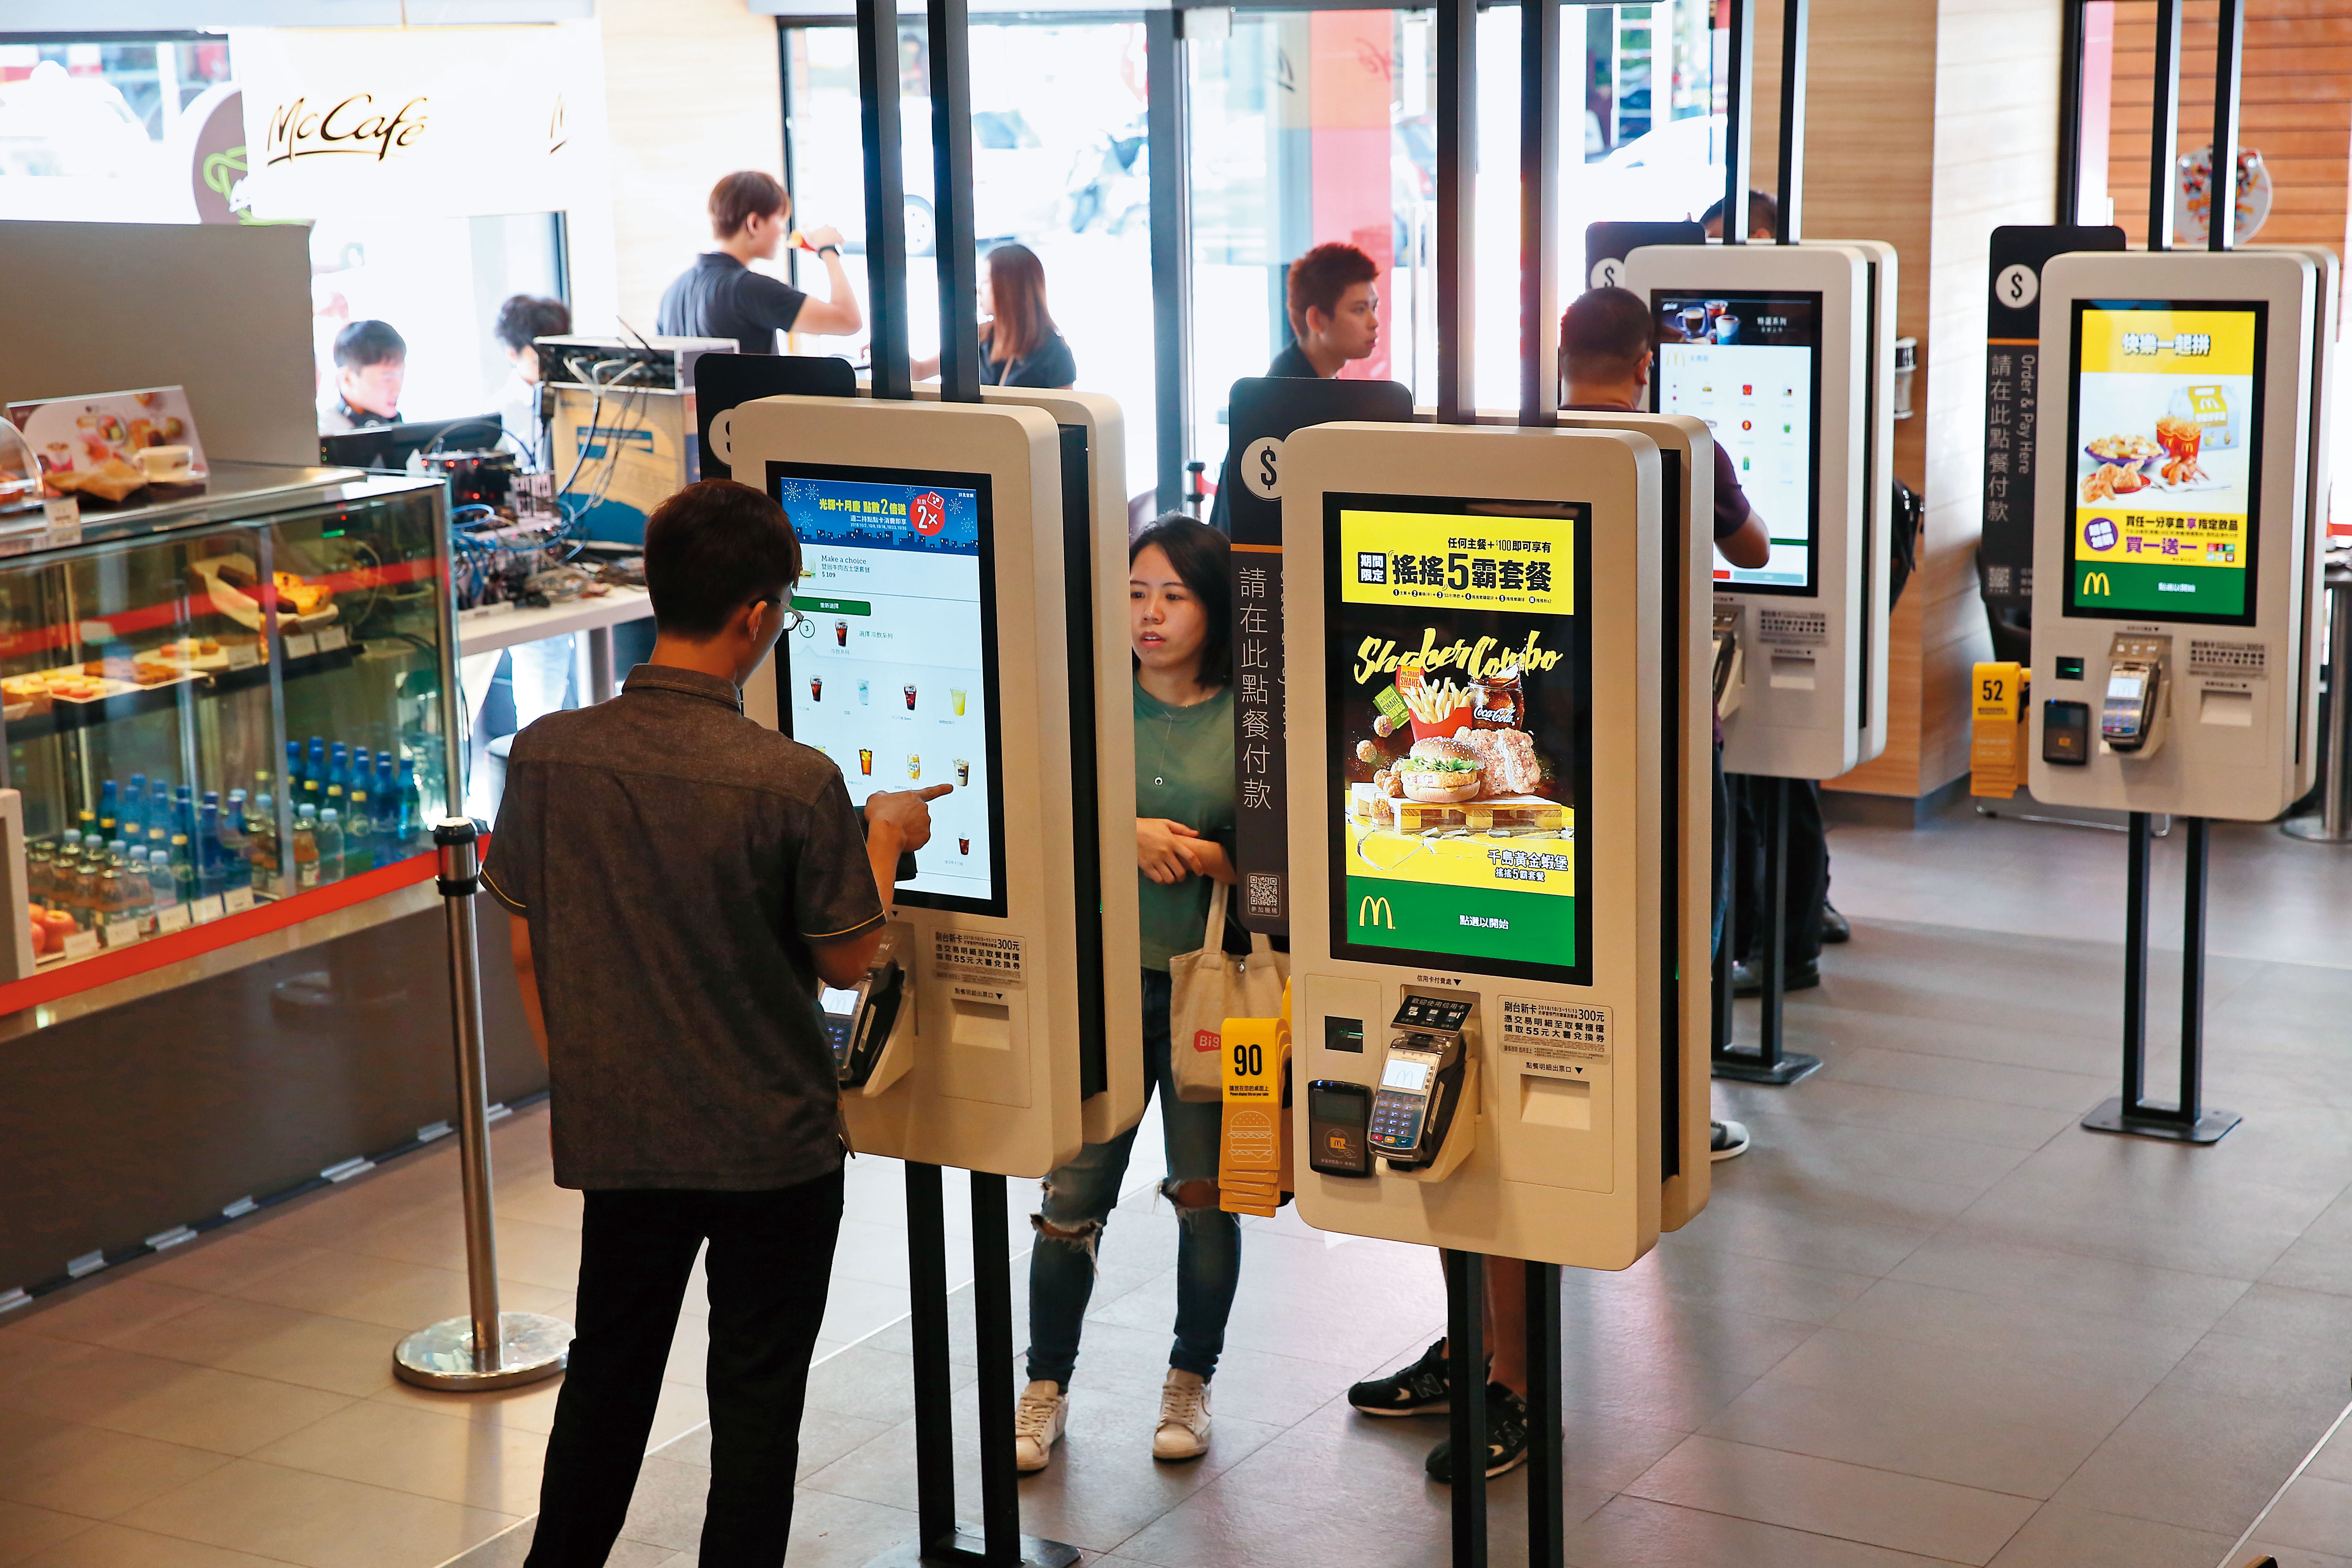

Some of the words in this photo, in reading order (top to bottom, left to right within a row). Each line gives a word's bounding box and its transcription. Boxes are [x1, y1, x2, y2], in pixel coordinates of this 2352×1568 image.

[267, 94, 427, 162] McCafé
[2020, 354, 2036, 394] Order
[2016, 413, 2034, 439] Pay
[1987, 354, 2011, 522] 請在此點餐付款
[2018, 441, 2033, 474] Here
[819, 498, 861, 512] 光輝十月慶
[863, 499, 907, 516] 點數2倍送
[850, 515, 907, 525] 週二持點點卡消費即享
[2126, 536, 2197, 555] 買一送一
[845, 556, 866, 564] choice
[1360, 555, 1383, 568] 期間
[1361, 568, 1384, 582] 限定
[1392, 553, 1552, 592] 搖搖5霸套餐
[1354, 627, 1472, 684] Shaker
[1469, 630, 1564, 679] Combo
[1239, 567, 1272, 810] 請在此點餐付款
[1400, 677, 1420, 688] SHAKE
[1983, 680, 2002, 700] 52
[1382, 695, 1401, 713] SHAKE
[1488, 849, 1568, 871] 千島黃金蝦堡
[1495, 867, 1545, 882] 搖搖5霸套餐
[1459, 914, 1509, 930] 點選以開始
[998, 938, 1020, 951] 300元
[1417, 975, 1452, 985] 信用卡付費處
[955, 988, 993, 998] 點餐明細出票口
[1411, 998, 1465, 1011] 歡迎使用信用卡
[1504, 1001, 1537, 1015] 刷台新卡
[1578, 1009, 1604, 1022] 300元
[1504, 1015, 1604, 1033] 憑交易明細至取餐櫃檯
[1504, 1024, 1604, 1042] 領取55元大薯兌換券
[1200, 1036, 1219, 1047] Big
[1234, 1044, 1262, 1076] 90
[1526, 1062, 1571, 1073] 點餐明細出票口
